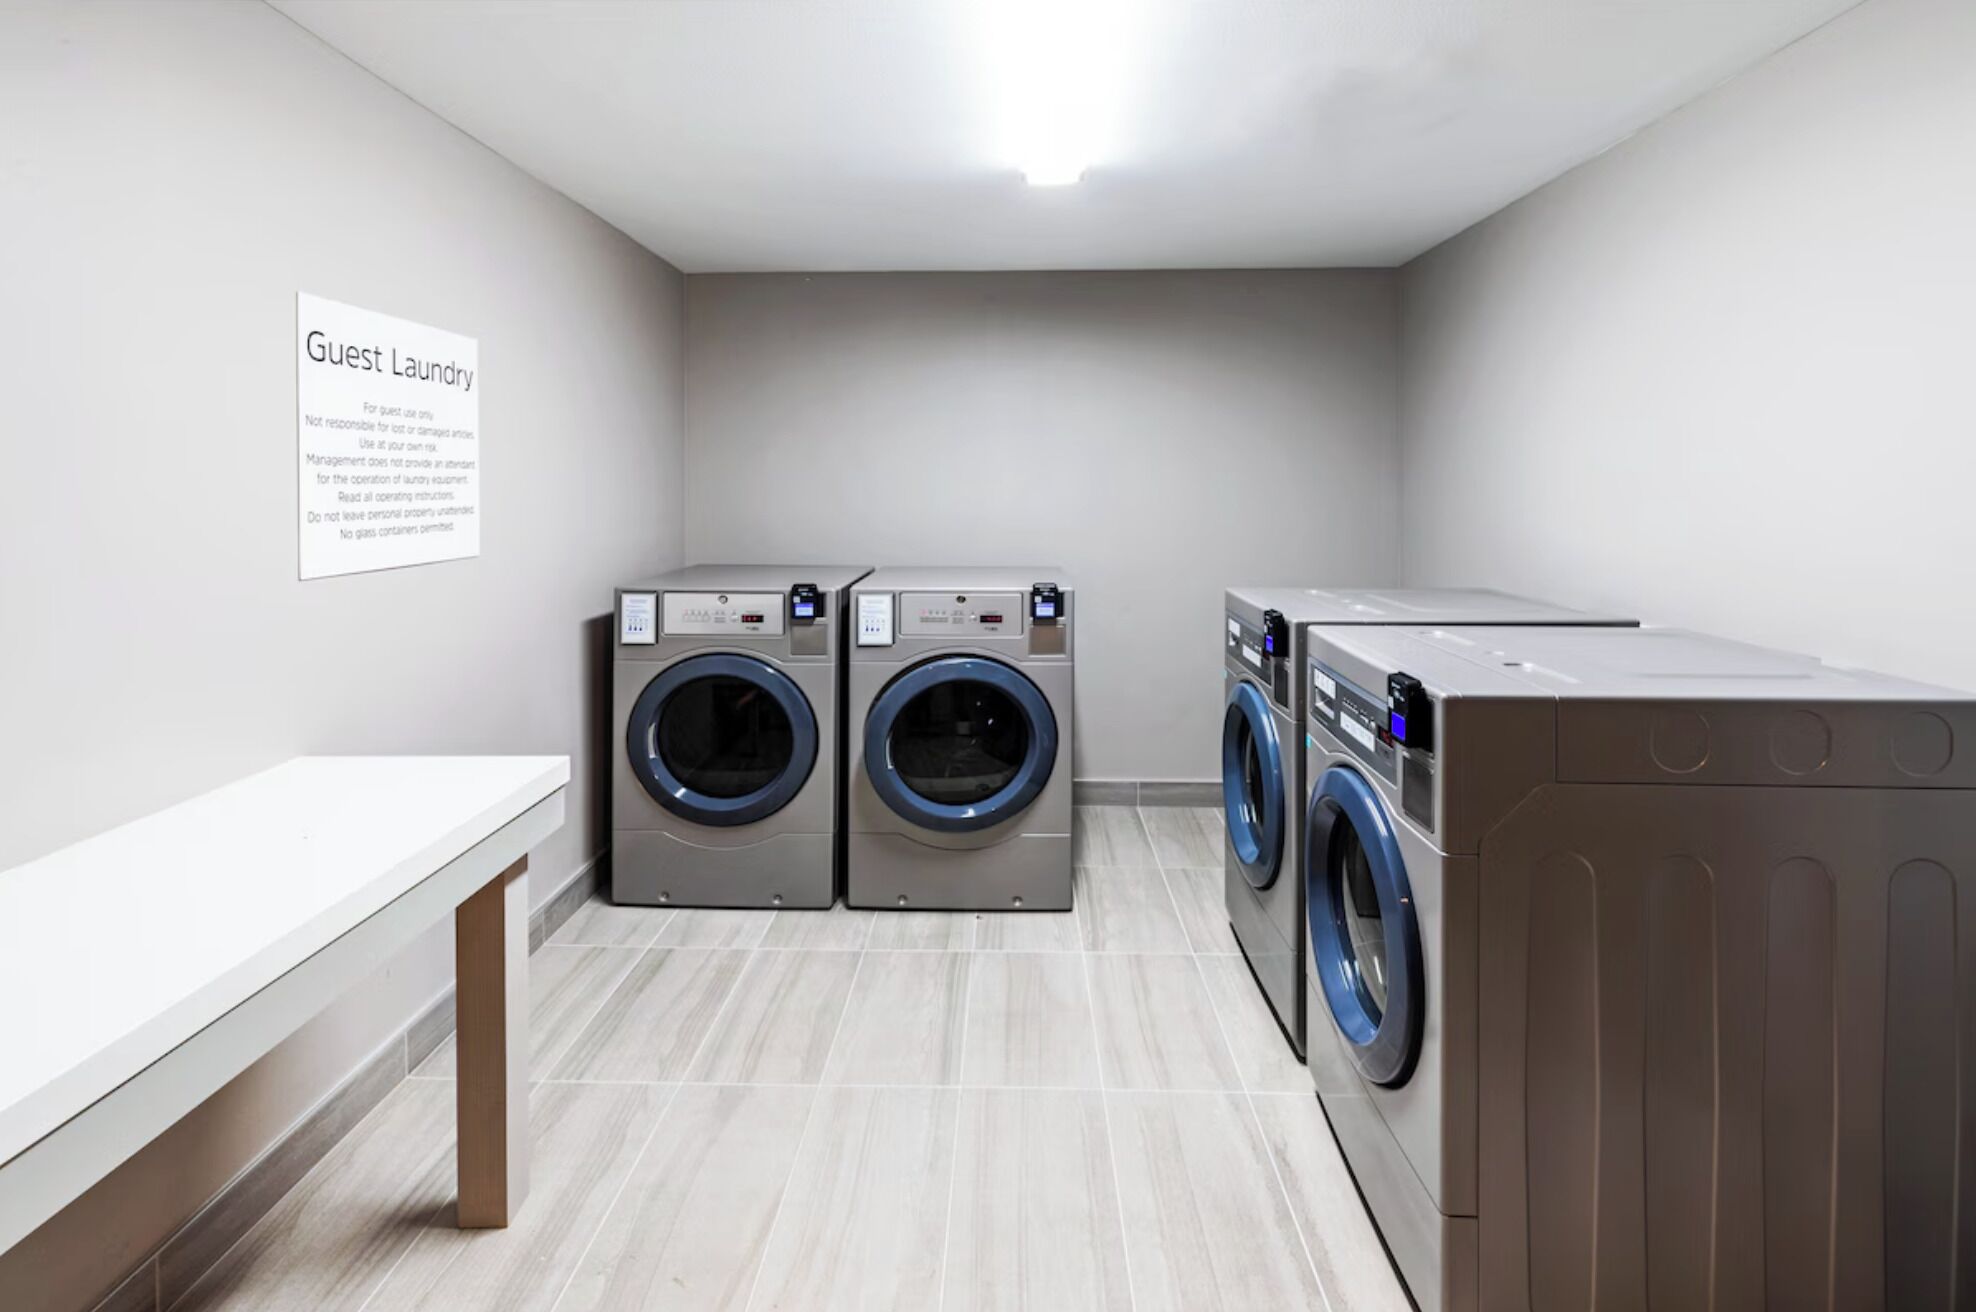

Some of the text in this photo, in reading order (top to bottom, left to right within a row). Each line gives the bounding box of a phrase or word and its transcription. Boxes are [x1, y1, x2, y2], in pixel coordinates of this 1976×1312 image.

[307, 330, 474, 392] Guest Laundry
[364, 402, 377, 414] For
[379, 404, 402, 418] guest
[403, 409, 416, 418] use
[305, 414, 324, 427] Not
[325, 416, 375, 433] responsible
[378, 421, 389, 432] for
[391, 422, 405, 434] lost
[407, 425, 416, 435] or
[418, 424, 450, 438] damaged
[359, 438, 374, 450] Use
[377, 440, 386, 450] at
[388, 442, 405, 452] your
[407, 443, 423, 452] own
[306, 453, 365, 467] Management
[368, 457, 388, 468] does
[390, 459, 403, 468] not
[405, 459, 432, 470] provide
[317, 473, 330, 484] for
[333, 474, 348, 484] the
[351, 473, 390, 486] operation
[392, 474, 401, 484] of
[403, 474, 430, 486] laundry
[338, 491, 361, 502] Read
[364, 491, 373, 502] all
[375, 491, 413, 503] operating
[307, 511, 321, 524] Do
[324, 512, 340, 523] not
[342, 510, 365, 521] leave
[368, 507, 402, 522] personal
[340, 528, 353, 539] No
[356, 526, 376, 540] glass
[378, 524, 418, 537] containers
